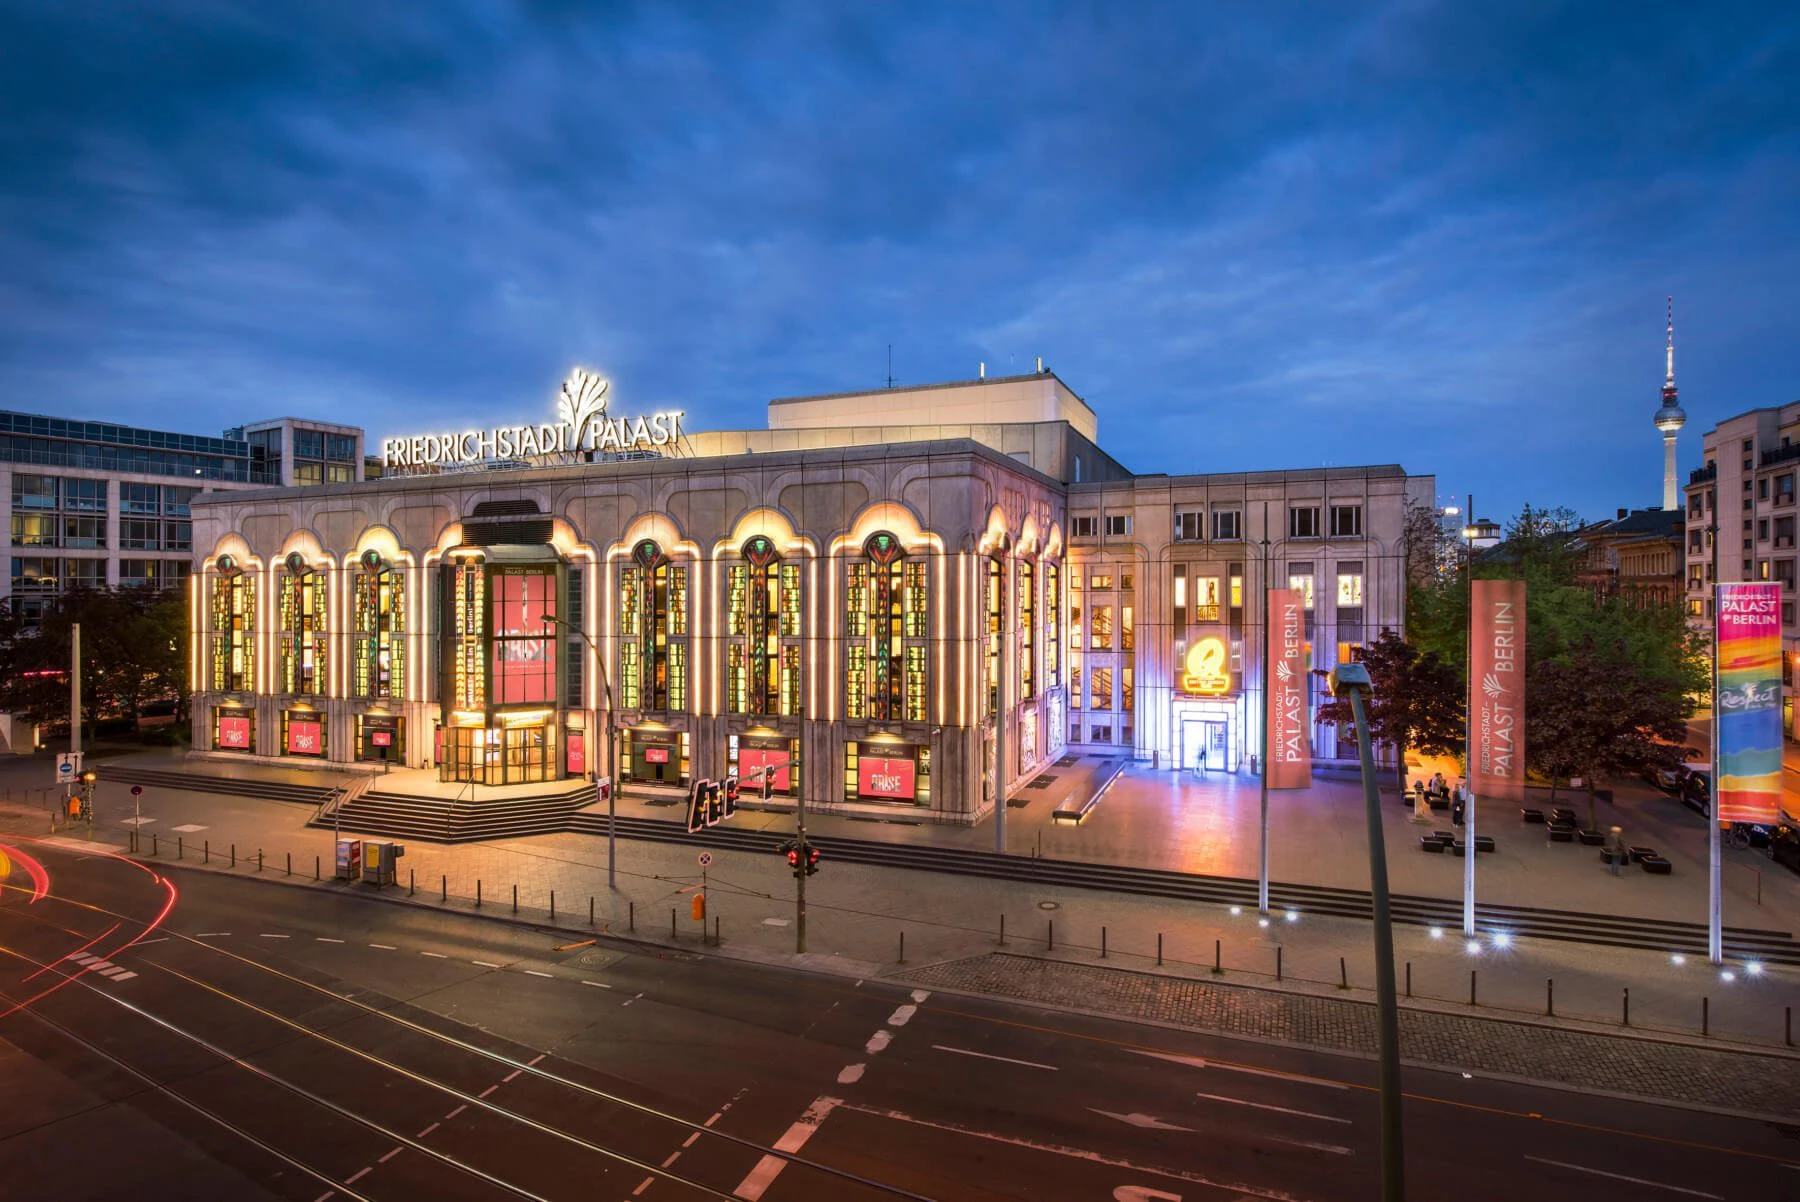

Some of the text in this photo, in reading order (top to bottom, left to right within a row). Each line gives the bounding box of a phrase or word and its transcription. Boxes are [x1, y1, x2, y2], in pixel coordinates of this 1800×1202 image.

[382, 411, 685, 467] FRIEDRICHSTADT PALAST
[1284, 603, 1299, 659] BERLIN
[1722, 601, 1777, 613] PALAST
[1733, 614, 1777, 625] BERLIN
[1494, 601, 1514, 672] BERLIN
[1286, 686, 1302, 762] PALAST
[1720, 686, 1778, 710] Respect
[1494, 702, 1514, 778] PALAST
